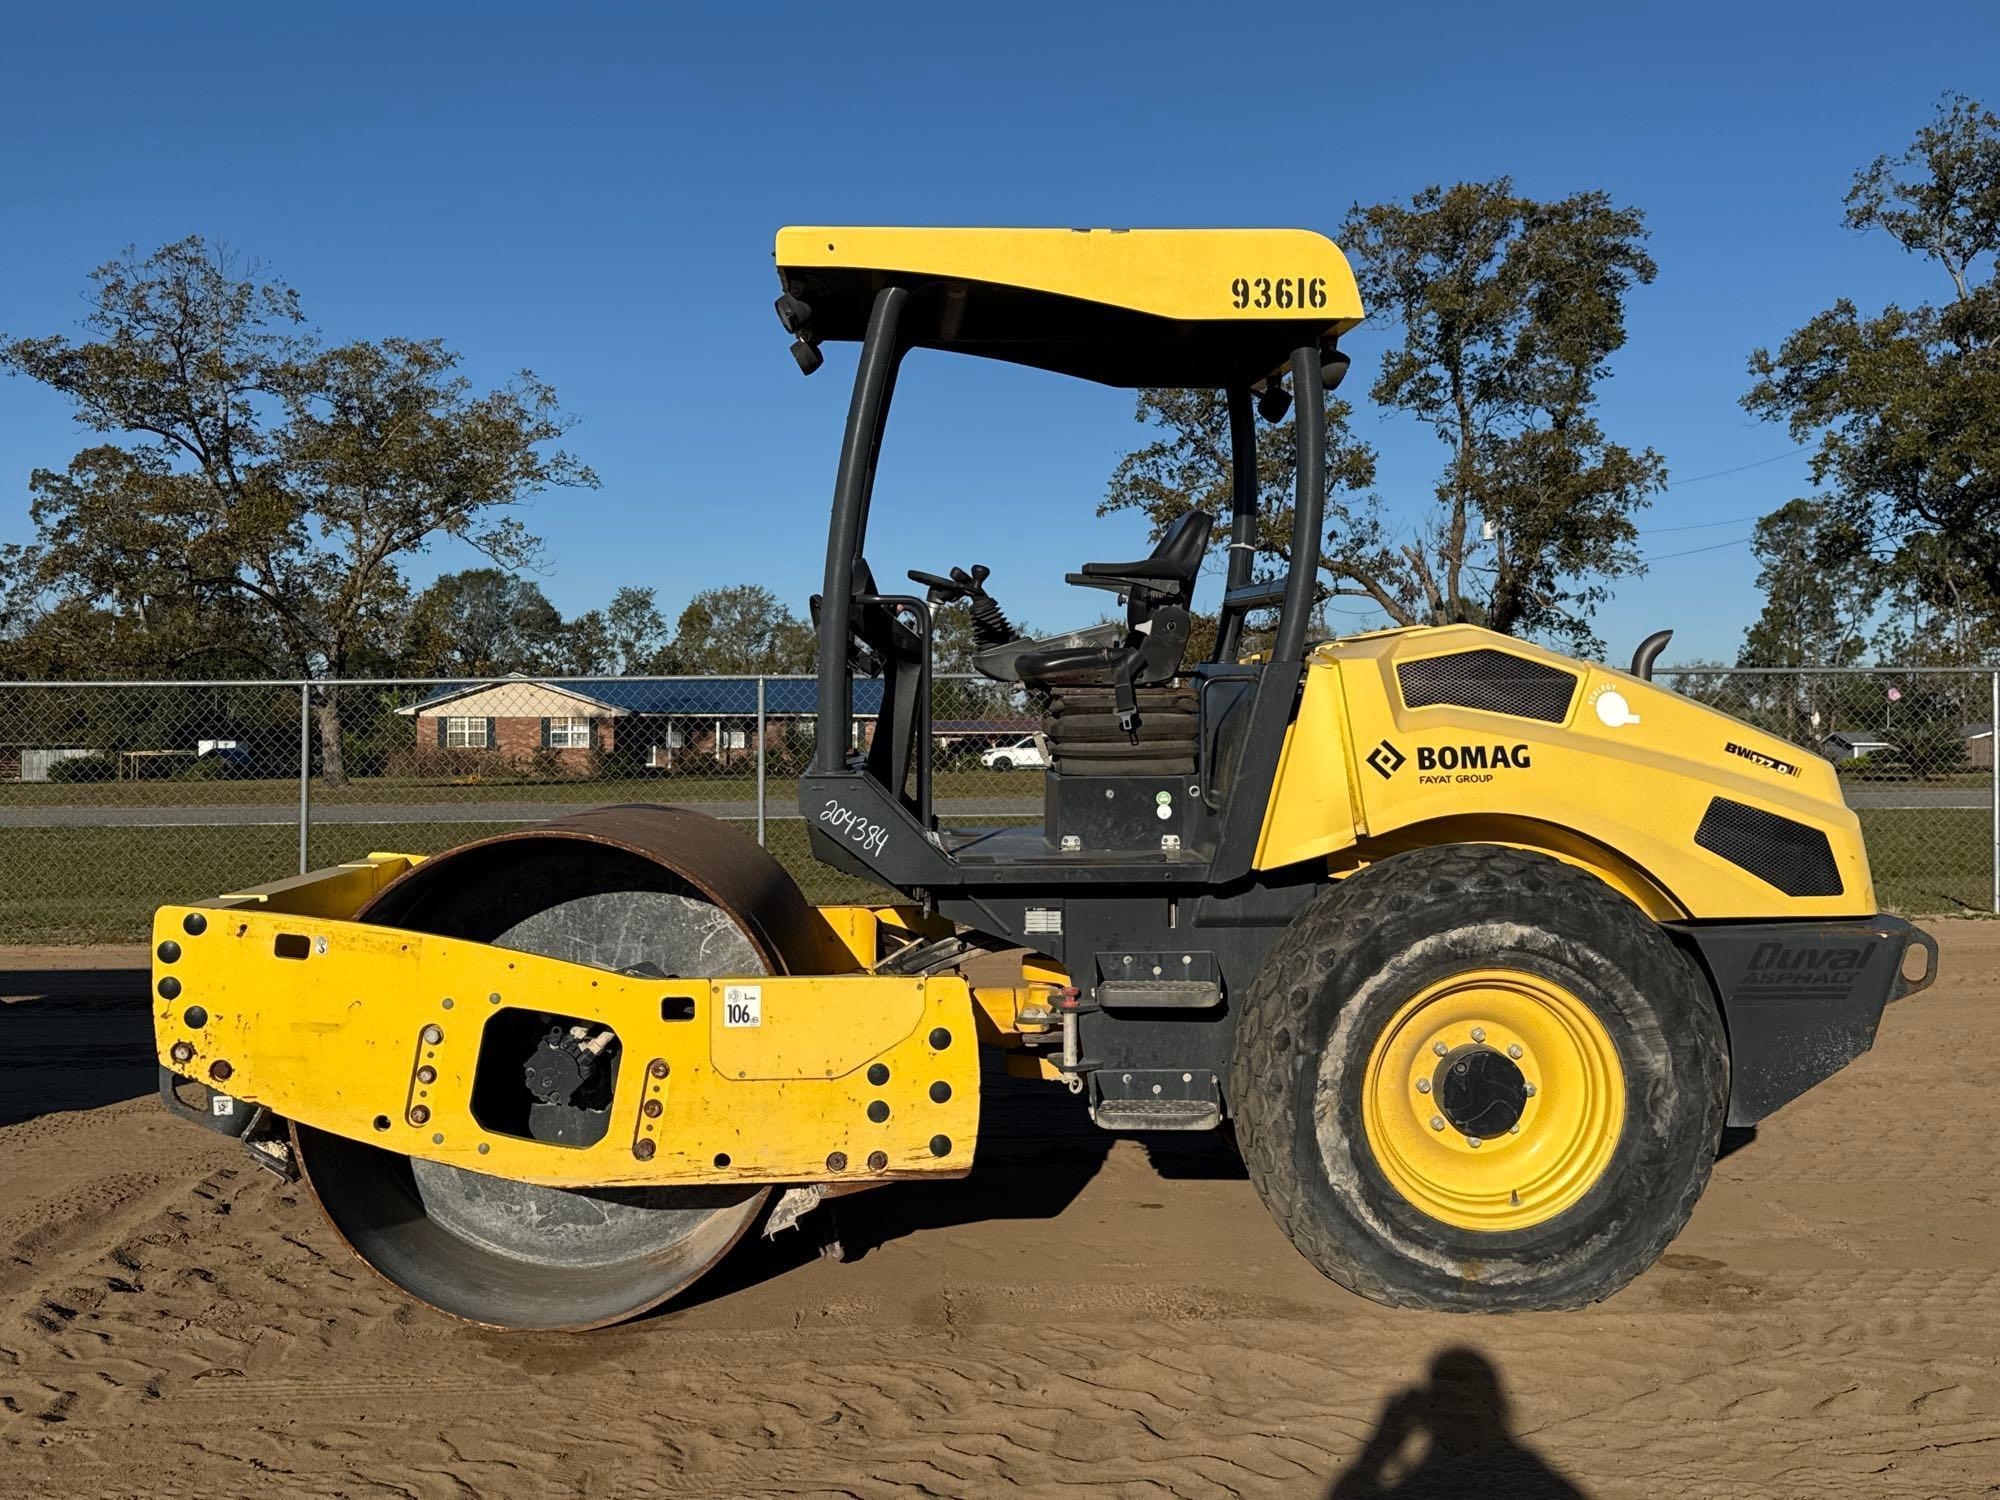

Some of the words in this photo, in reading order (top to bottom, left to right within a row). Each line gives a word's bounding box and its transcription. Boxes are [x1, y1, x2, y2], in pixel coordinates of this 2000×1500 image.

[1231, 277, 1327, 309] 93616
[1587, 683, 1617, 705] ECOLOGY
[1416, 744, 1531, 771] BOMAG
[1419, 775, 1452, 785] FAYAT
[1455, 774, 1493, 784] GROUP
[819, 799, 889, 858] 204384
[1747, 941, 1878, 970] Duval
[1741, 972, 1861, 984] ASPHALT
[727, 1004, 750, 1024] 106
